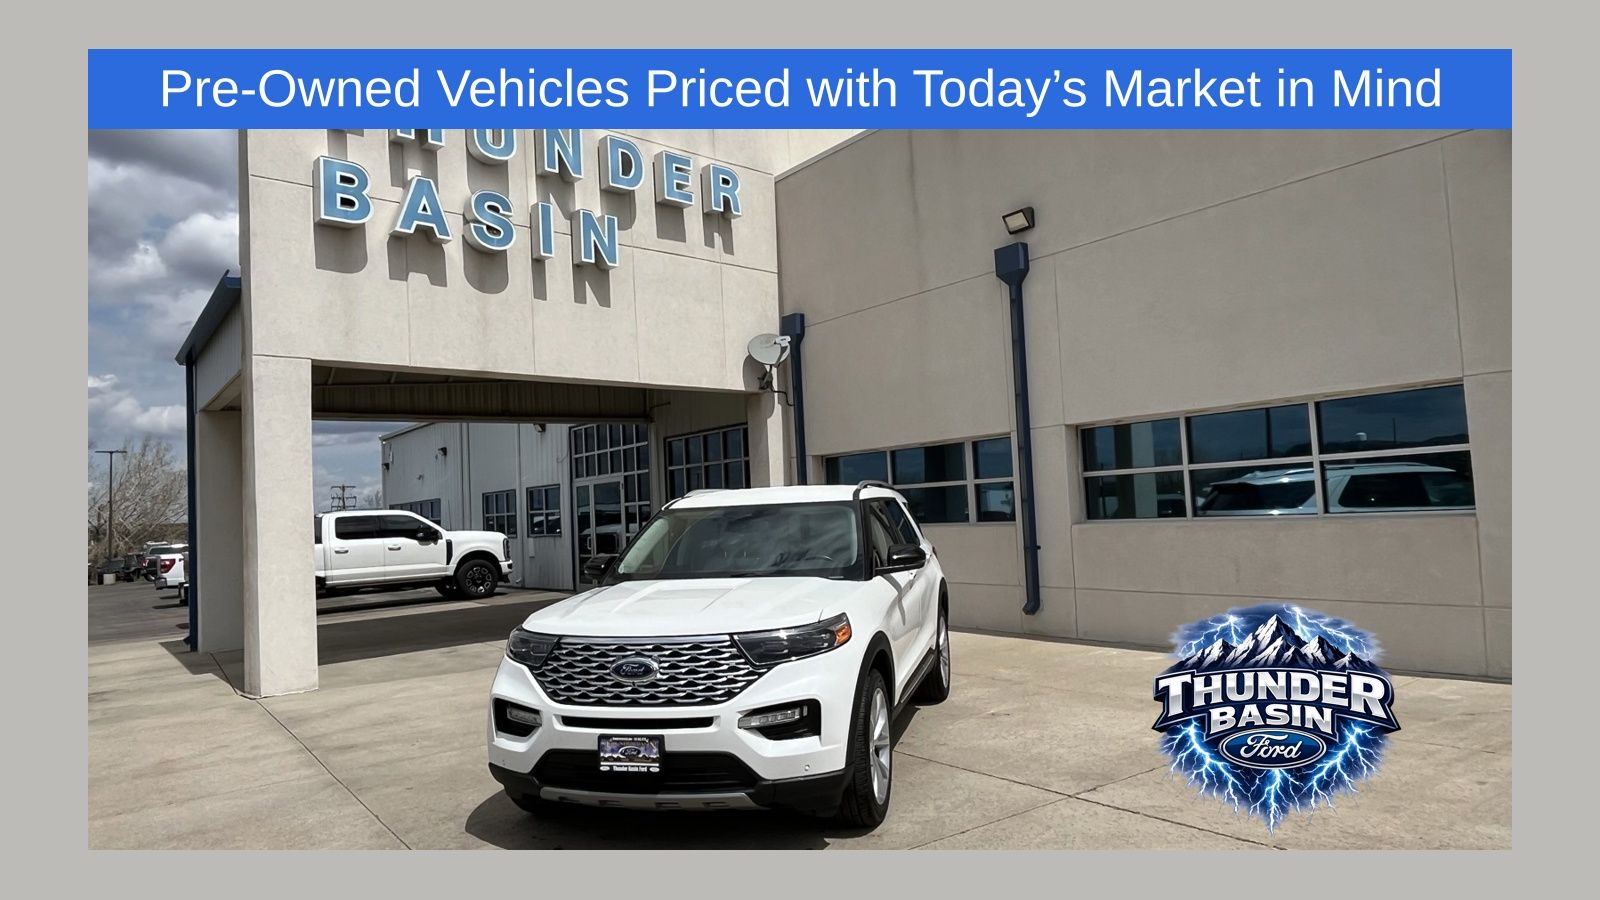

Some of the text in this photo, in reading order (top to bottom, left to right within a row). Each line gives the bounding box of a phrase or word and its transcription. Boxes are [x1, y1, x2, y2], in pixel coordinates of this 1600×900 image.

[313, 154, 620, 271] BASIN
[347, 128, 742, 218] UNDER
[620, 663, 645, 676] Ford
